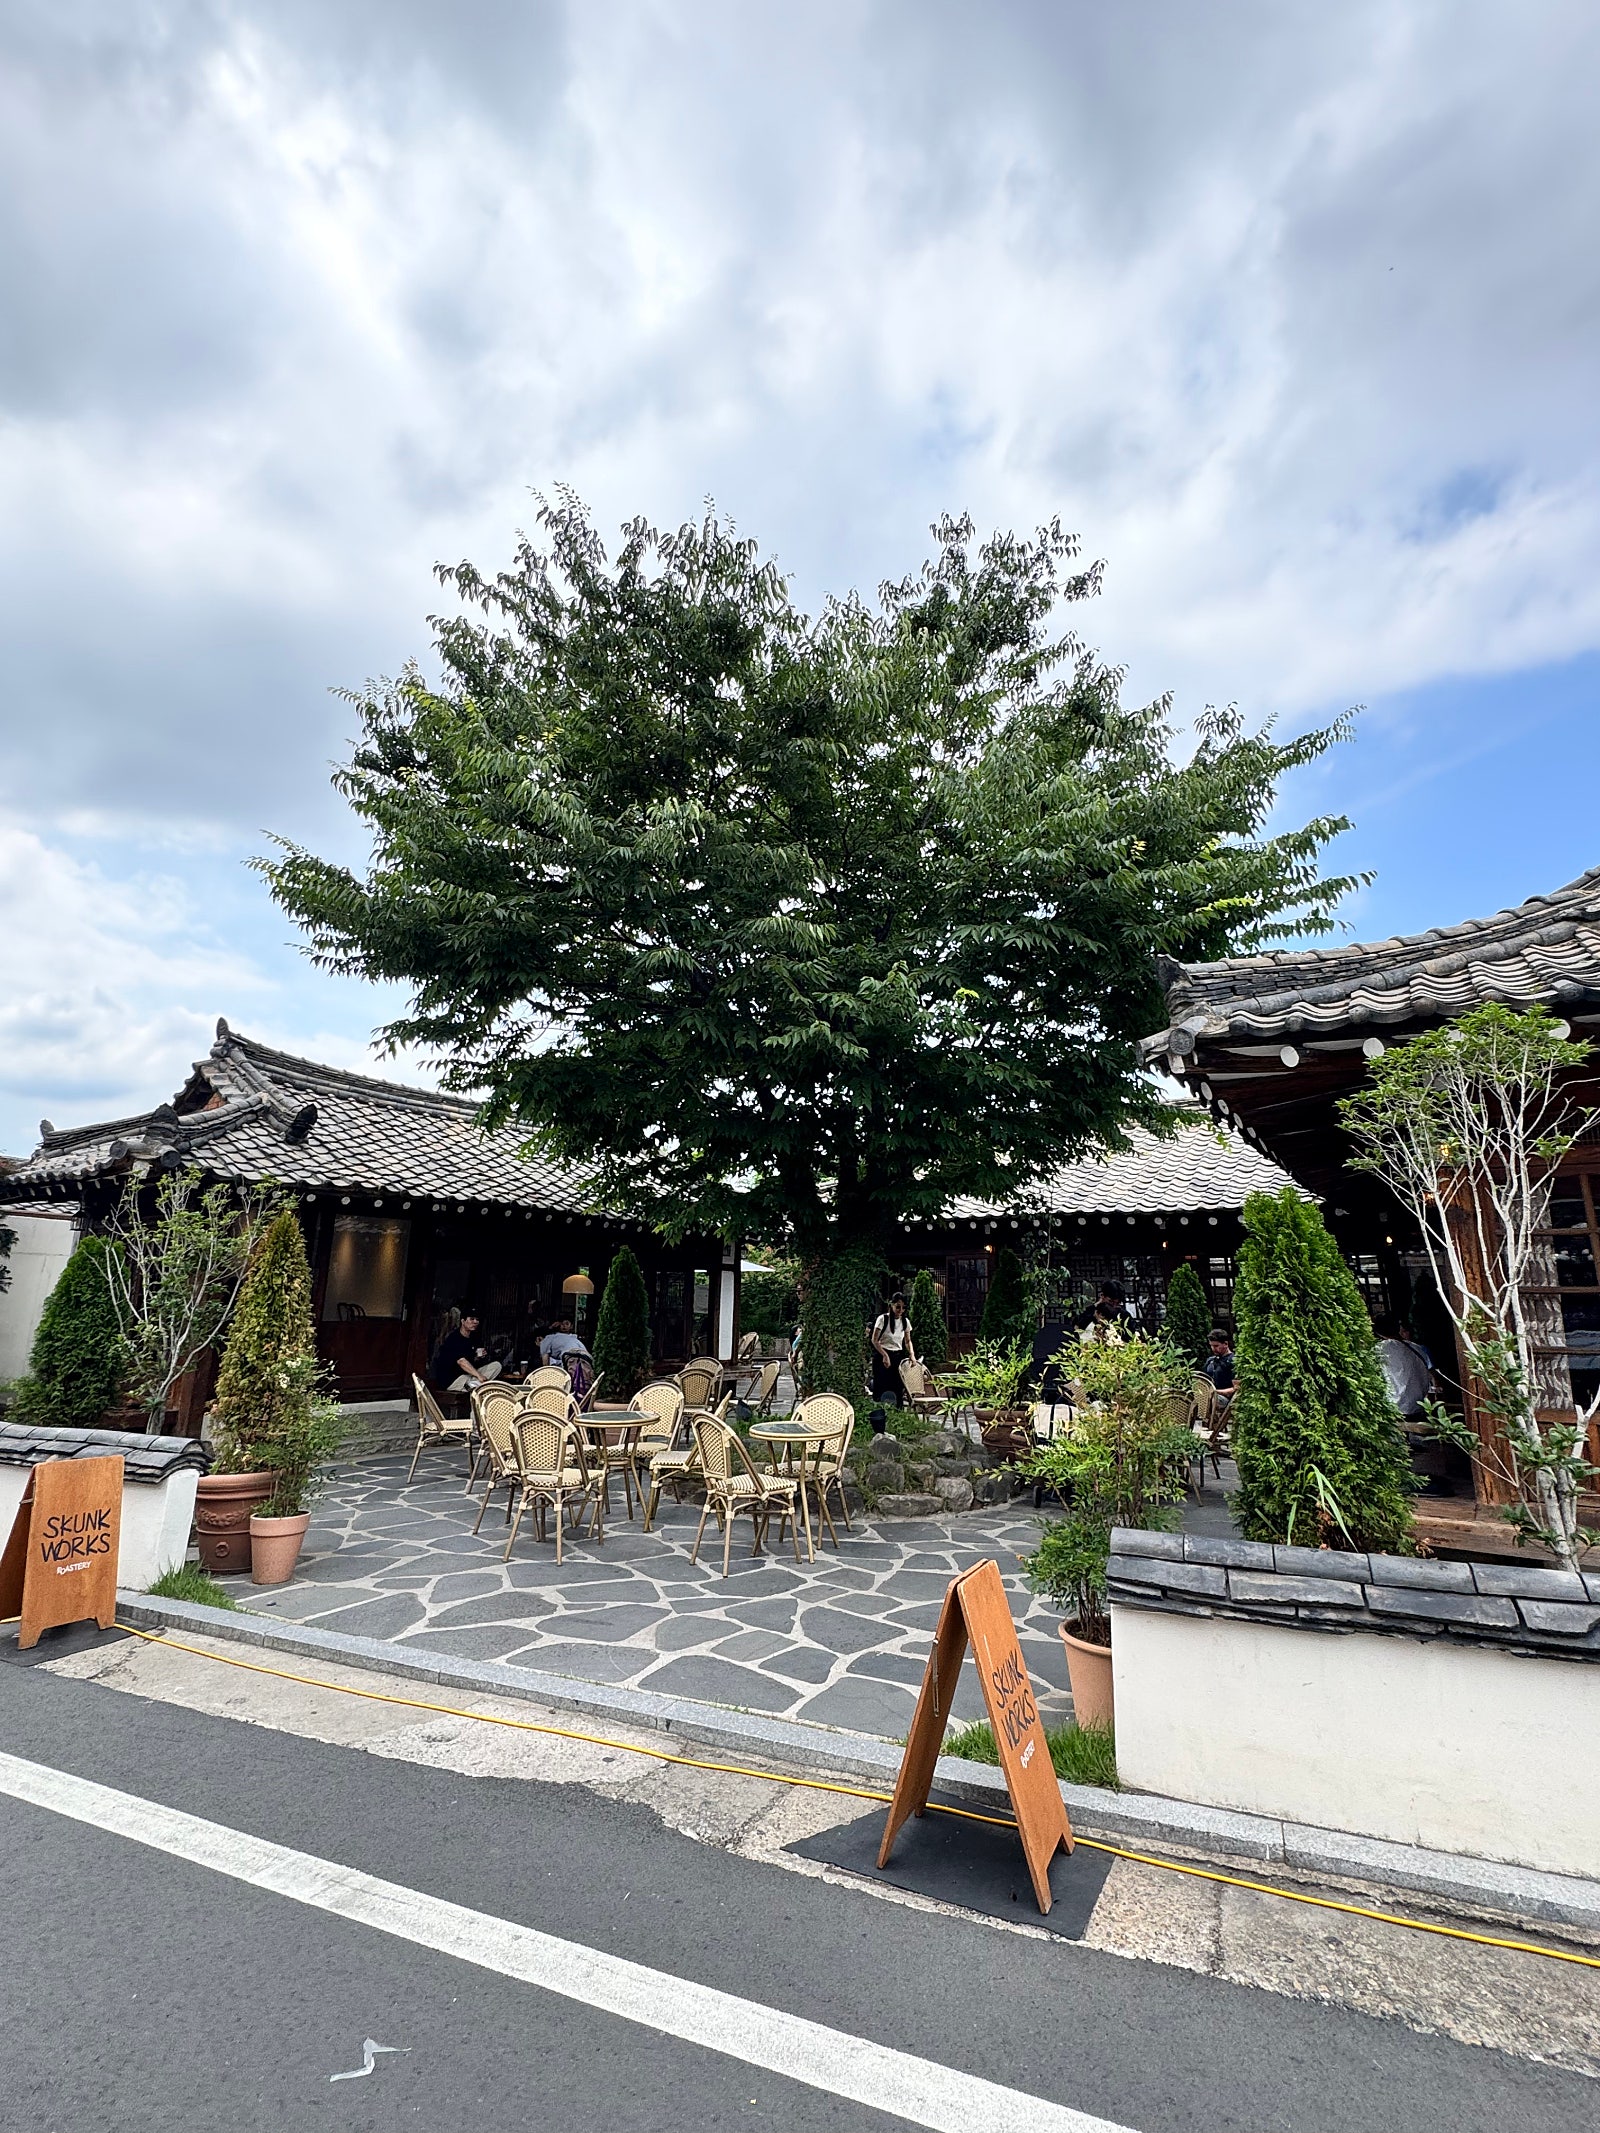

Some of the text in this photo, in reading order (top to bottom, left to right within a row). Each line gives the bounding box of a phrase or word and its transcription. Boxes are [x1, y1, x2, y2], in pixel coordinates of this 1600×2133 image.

[43, 1508, 111, 1538] SKUNK
[41, 1533, 110, 1562] WORKS
[56, 1560, 92, 1575] ROASTERY
[992, 1648, 1025, 1709] SKUNK
[1001, 1688, 1036, 1751] WORKS
